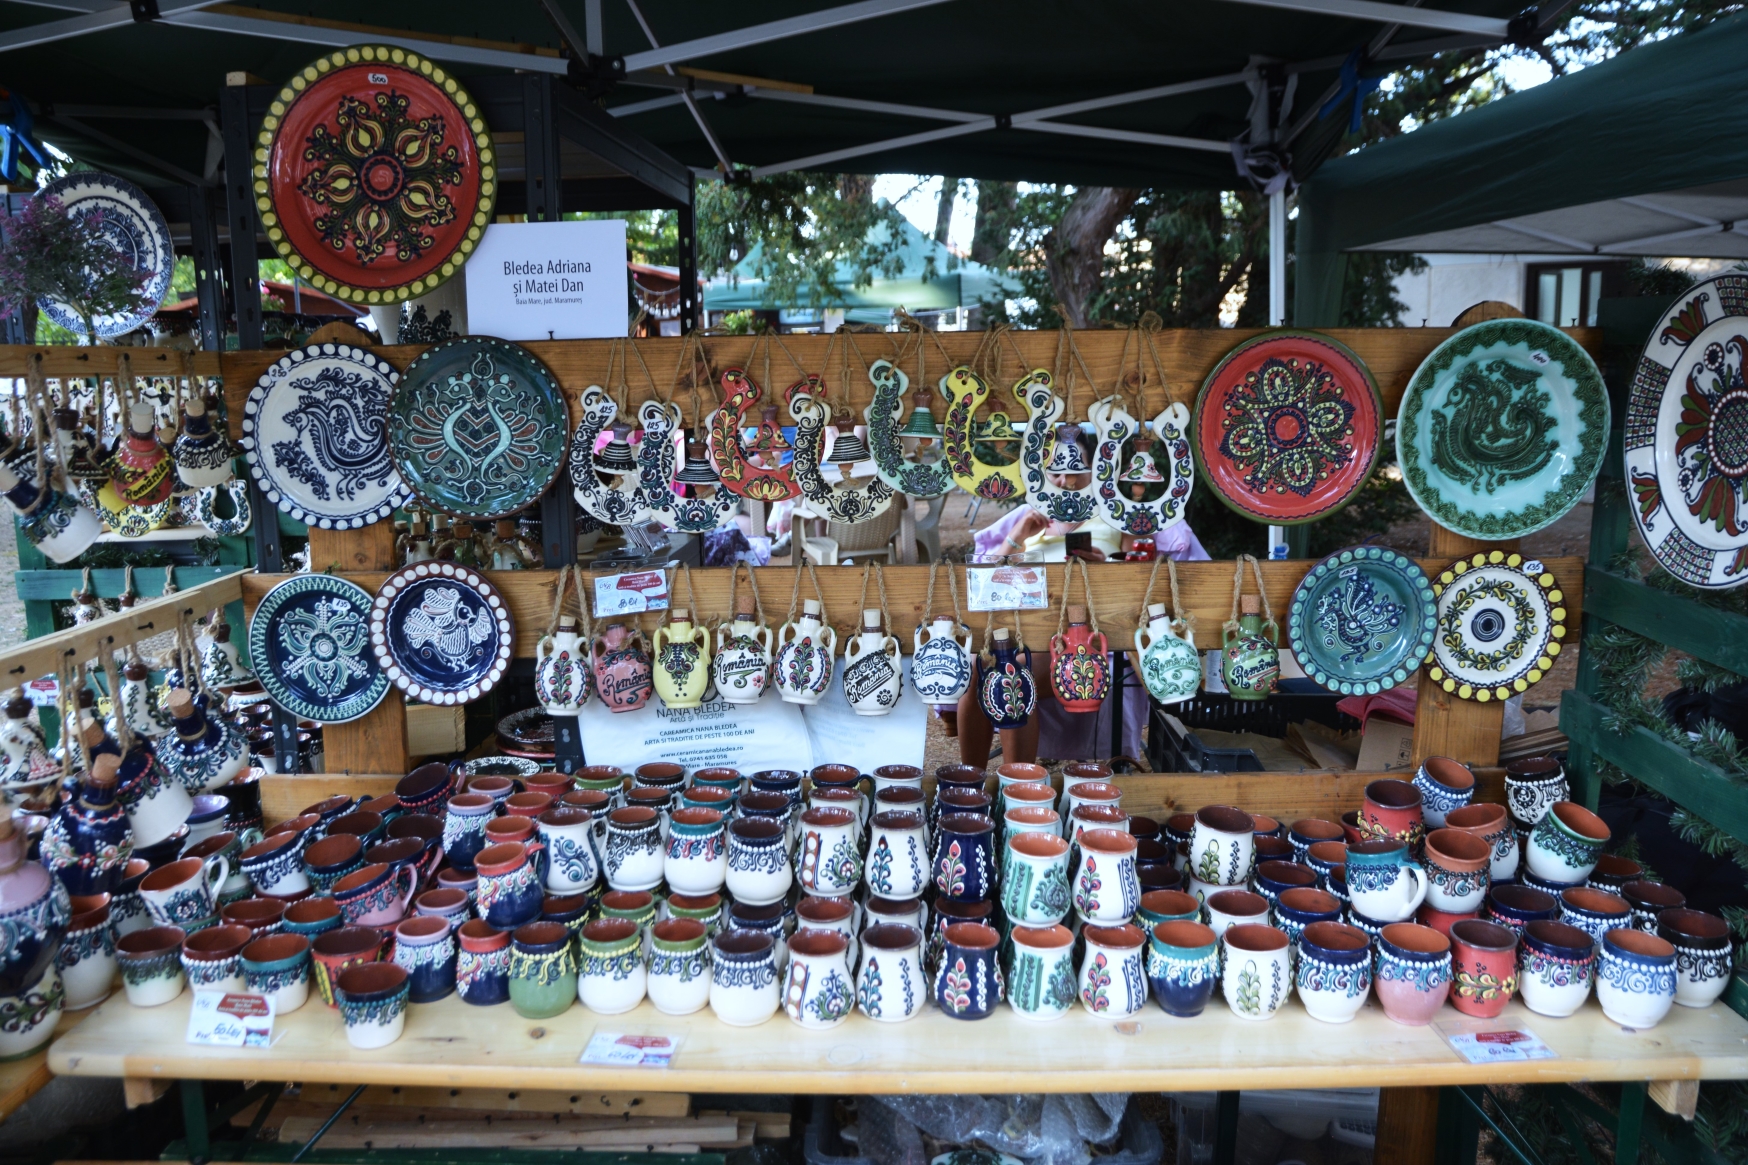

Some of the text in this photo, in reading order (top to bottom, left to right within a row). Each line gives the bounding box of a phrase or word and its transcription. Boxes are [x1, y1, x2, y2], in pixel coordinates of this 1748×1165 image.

[371, 73, 387, 83] 500
[503, 259, 591, 276] Bledea Adriana
[513, 278, 584, 298] și Matei Dan
[543, 297, 553, 306] jud.
[271, 368, 288, 378] 250
[646, 420, 664, 430] 125
[335, 599, 348, 608] 135
[713, 651, 766, 685] România
[656, 702, 736, 718] NANA BLEDEA
[695, 724, 713, 733] NANA
[714, 723, 738, 731] BLEDEA
[644, 738, 660, 747] ARTA
[667, 735, 694, 743] TRADITIE
